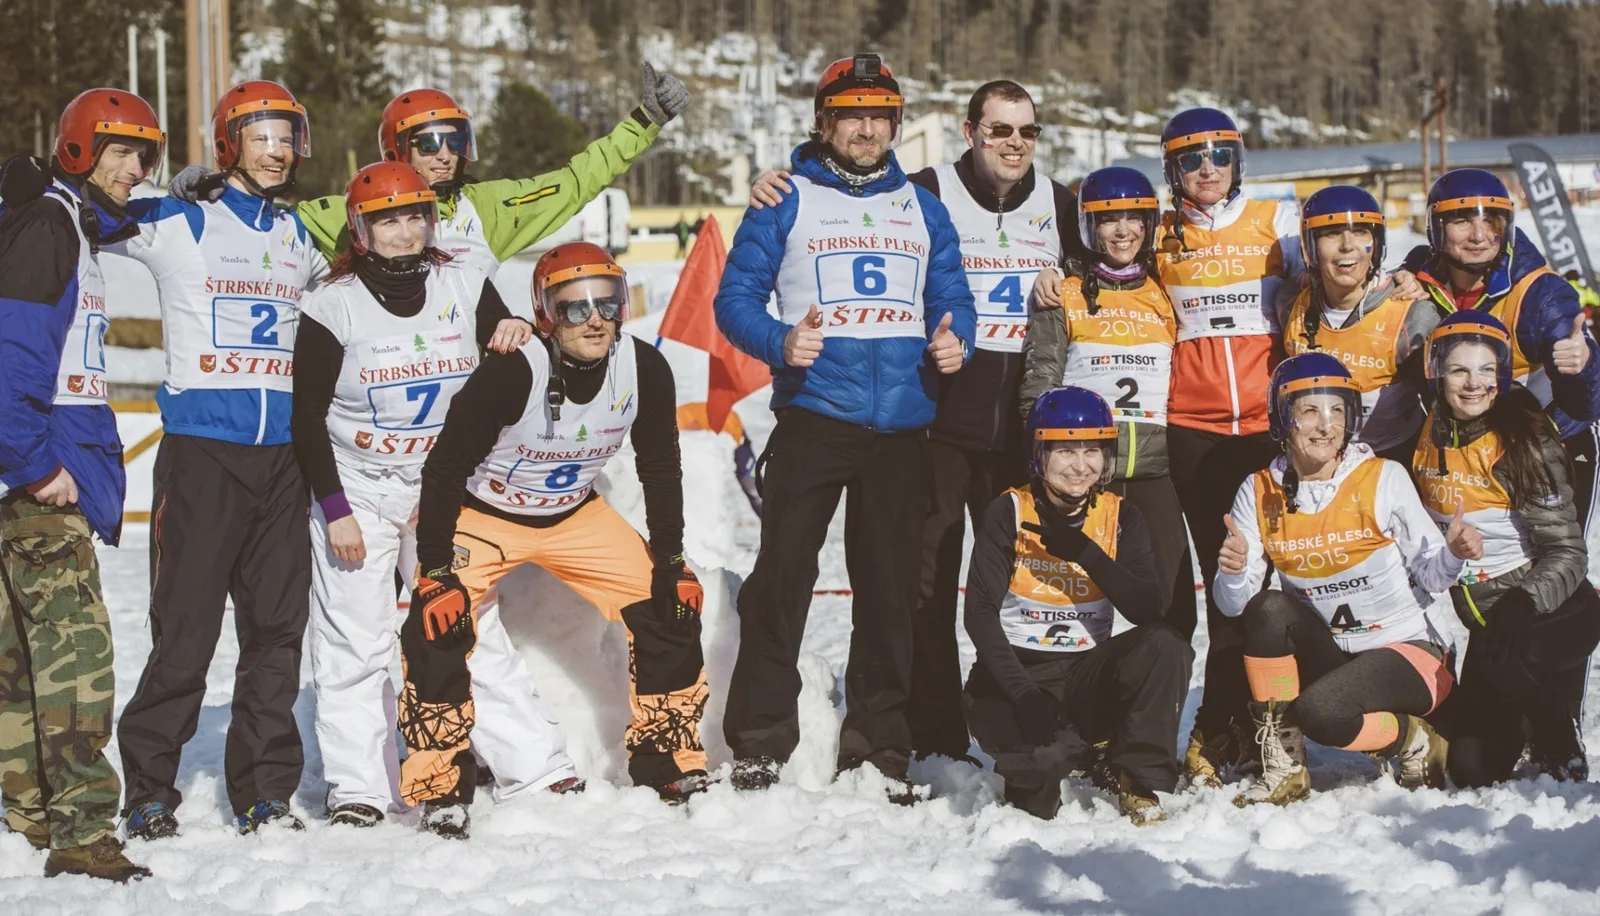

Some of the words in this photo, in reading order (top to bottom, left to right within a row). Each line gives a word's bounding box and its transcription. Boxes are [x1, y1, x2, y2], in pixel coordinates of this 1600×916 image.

[808, 233, 879, 254] ŠTRBSKÉ
[884, 238, 925, 257] PLESO
[1227, 246, 1271, 256] PLESO
[962, 255, 1014, 269] RBSKÉ
[1191, 259, 1245, 280] 2015
[205, 276, 271, 296] ŠTRBSKÉ
[853, 255, 887, 296] 6
[988, 276, 1024, 312] 4
[1200, 293, 1259, 305] TISSOT
[250, 303, 278, 346] 2
[1129, 310, 1167, 326] PLESO
[360, 358, 433, 384] ŠTRBSKÉ
[437, 355, 477, 374] PLESO
[1111, 354, 1157, 366] TISSOT
[1343, 352, 1385, 369] PLESO
[1114, 377, 1140, 409] 2
[406, 382, 441, 426] 7
[515, 444, 585, 460] ŠTRBSKÉ
[544, 463, 582, 489] 8
[1452, 471, 1490, 488] PLESO
[1267, 533, 1324, 552] ŠTRBSKÉ
[1327, 528, 1373, 544] PLESO
[1293, 547, 1349, 571] 2015
[1031, 575, 1089, 597] 2015
[1313, 575, 1369, 595] TISSOT
